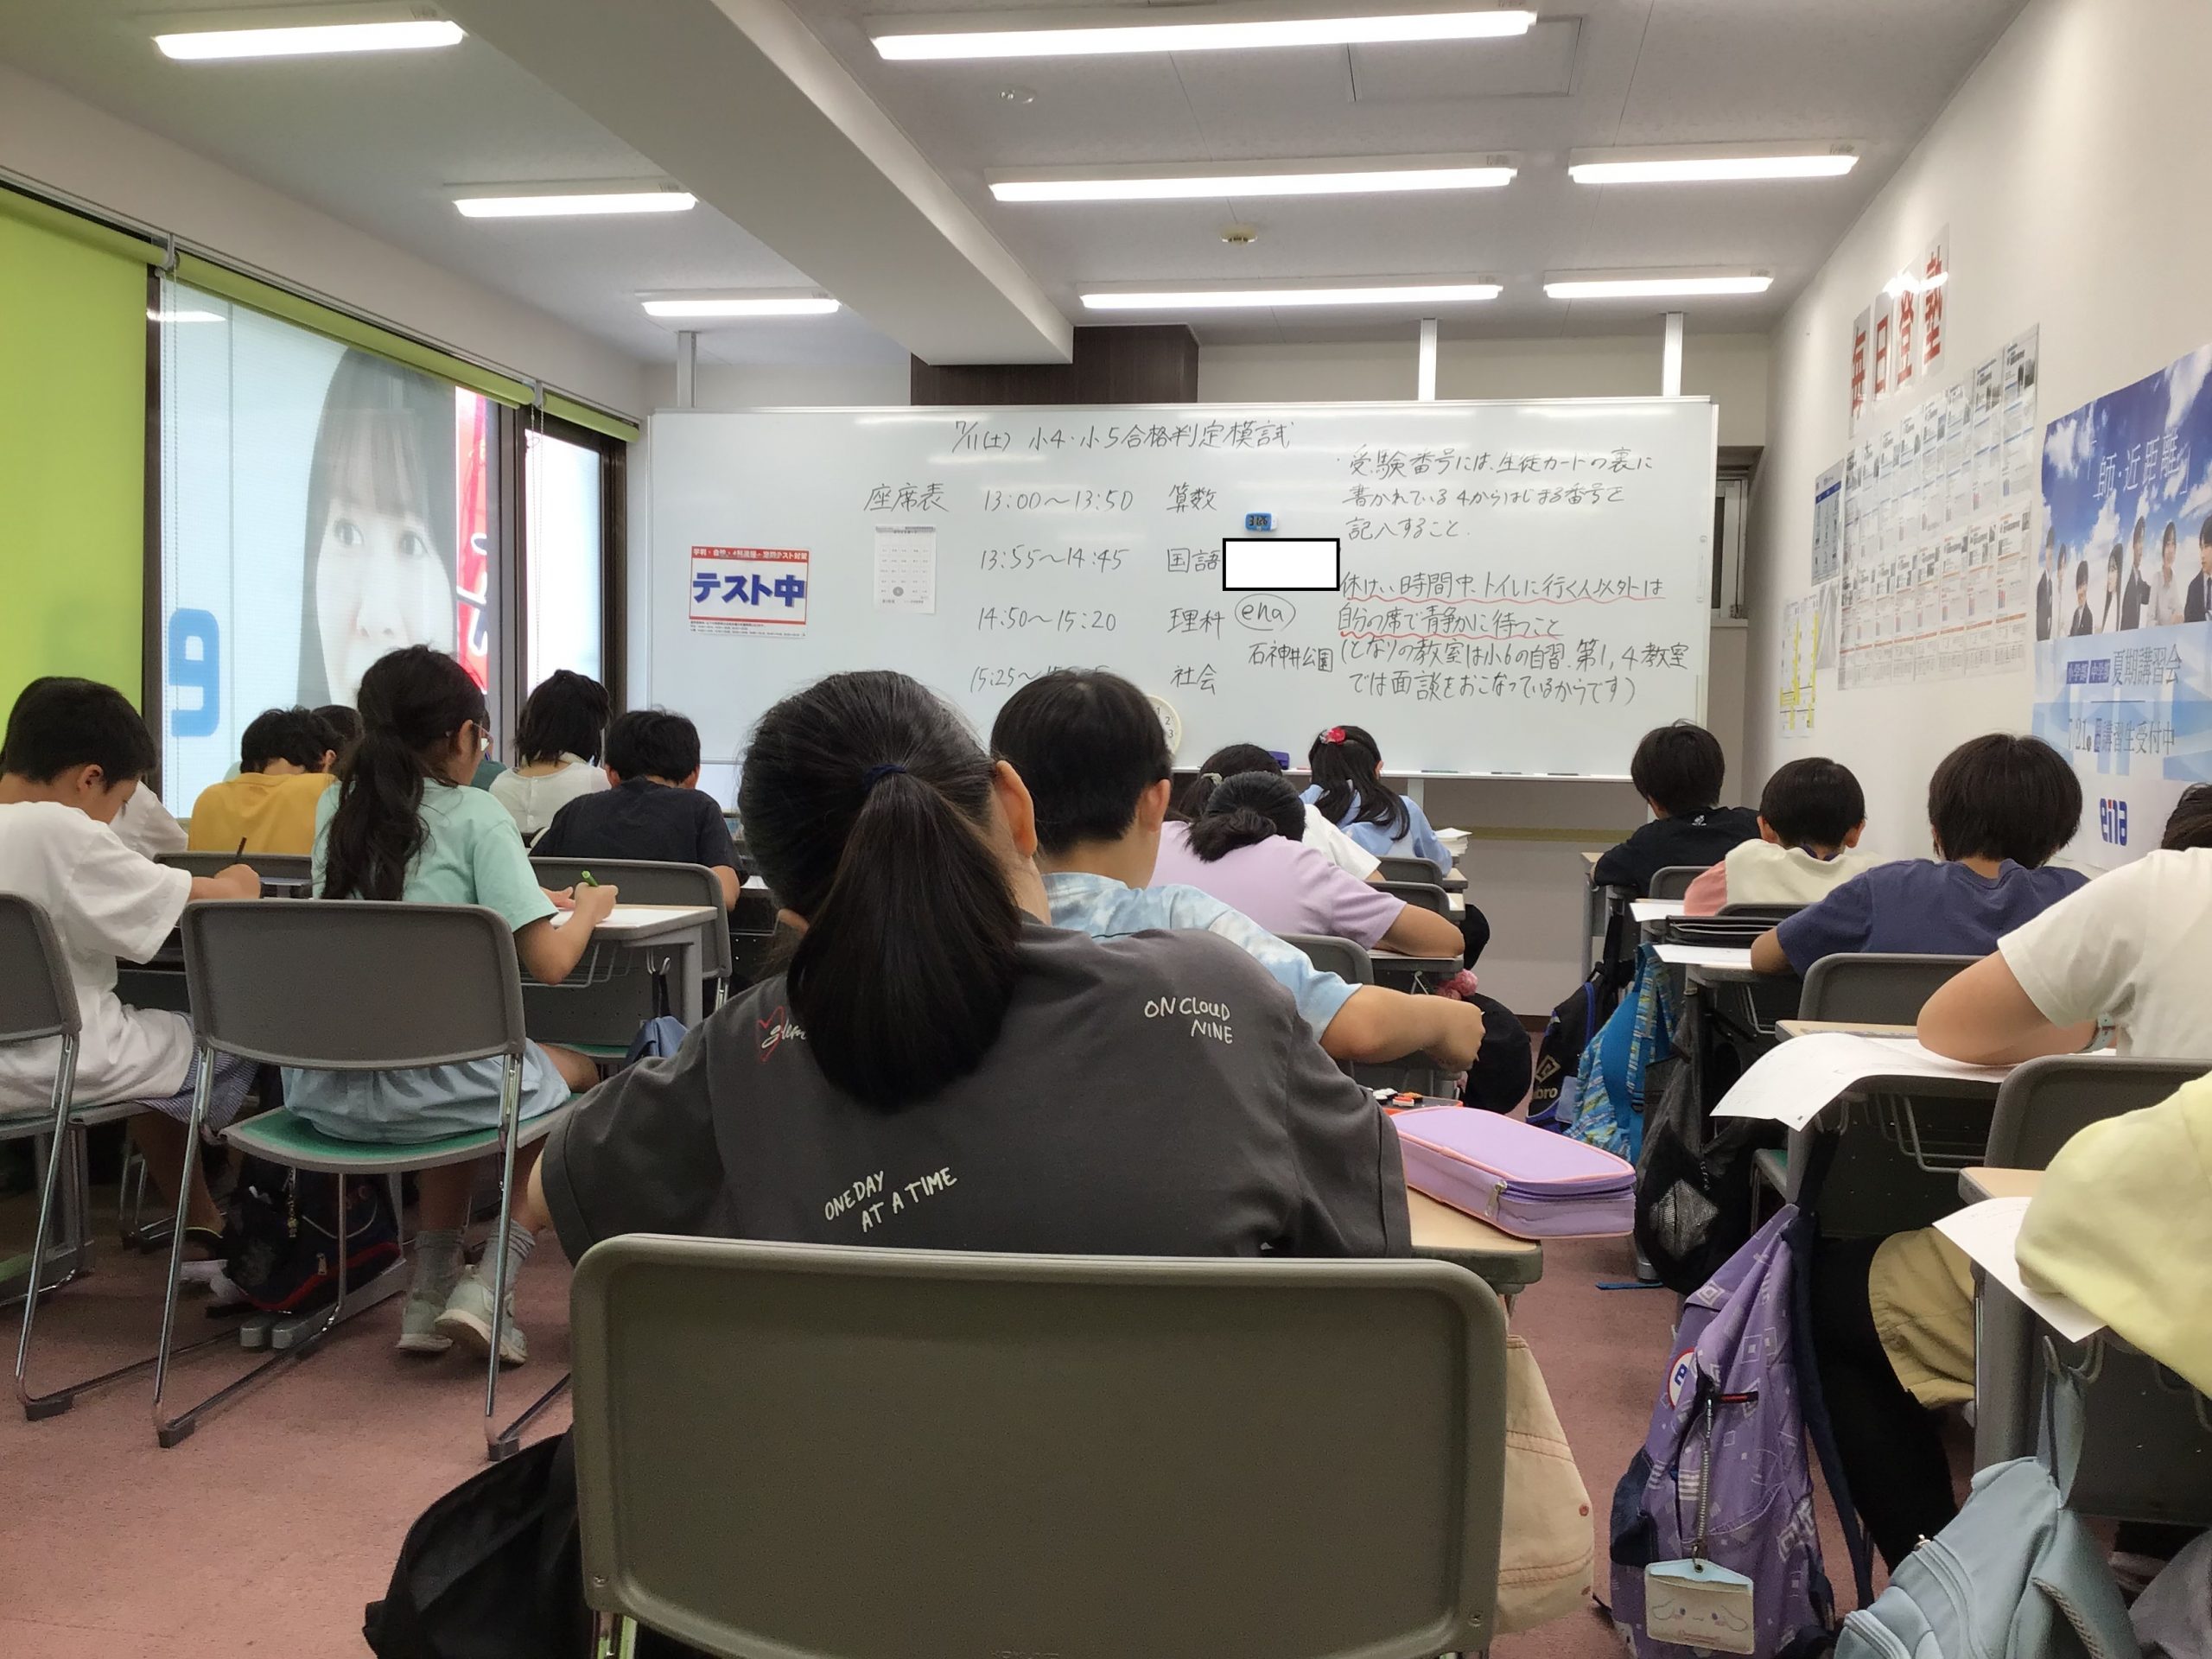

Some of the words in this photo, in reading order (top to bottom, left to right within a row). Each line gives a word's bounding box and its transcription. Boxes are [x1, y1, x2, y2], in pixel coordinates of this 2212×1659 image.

[863, 482, 950, 512] 座席表
[1166, 482, 1217, 513] 算数
[1166, 548, 1221, 573] 国語
[692, 572, 806, 607] テスト中
[1167, 607, 1226, 640] 理科
[1242, 602, 1285, 622] ena
[1338, 601, 1565, 638] 自分の席で静かに待つこと
[1249, 640, 1333, 673] 石神井公園
[2112, 644, 2183, 686] 夏期講習会
[1170, 664, 1218, 695] 社会
[2100, 798, 2127, 846] ena
[1144, 996, 1177, 1018] ON
[1191, 1019, 1233, 1044] NINE
[824, 1189, 856, 1221] ONE
[853, 1170, 884, 1201] DAY
[862, 1202, 885, 1232] AT
[893, 1192, 905, 1214] A
[904, 1166, 957, 1203] TIME
